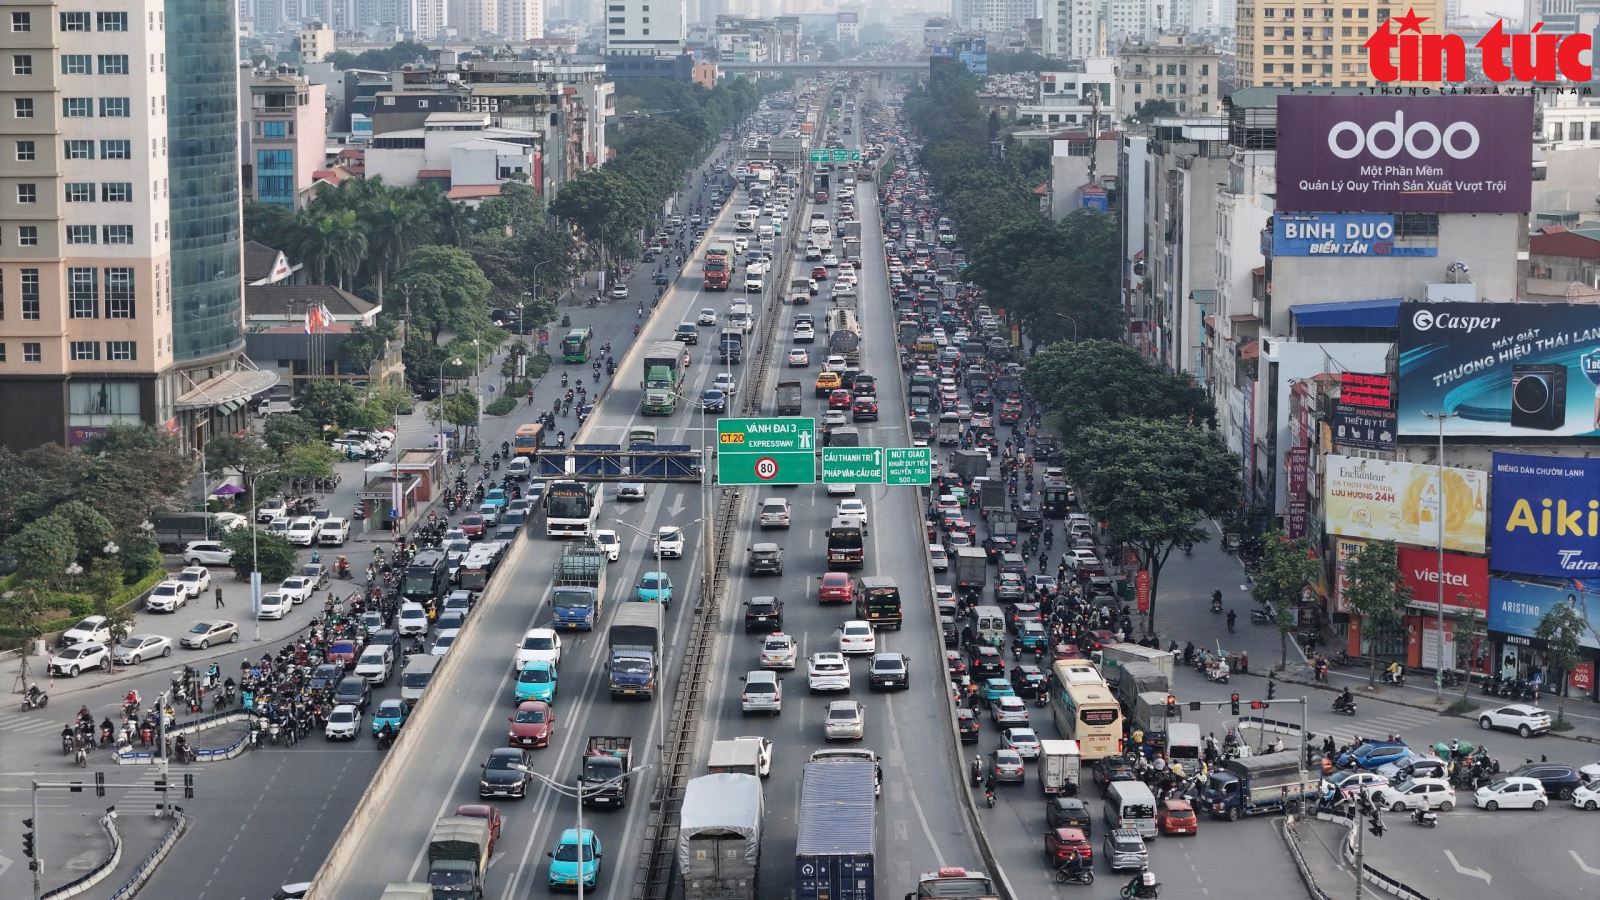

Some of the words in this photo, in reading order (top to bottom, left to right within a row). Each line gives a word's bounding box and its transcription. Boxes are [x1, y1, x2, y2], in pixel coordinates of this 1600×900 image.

[1328, 110, 1480, 160] odoo
[1360, 165, 1383, 178] Một
[1384, 164, 1413, 176] Phần
[1415, 164, 1444, 176] Mềm
[1299, 180, 1329, 192] Quản
[1331, 180, 1344, 194] Lý
[1346, 181, 1369, 194] Quy
[1371, 179, 1401, 191] Trình
[1402, 179, 1424, 191] Sản
[1426, 178, 1453, 191] Xuất
[1454, 180, 1483, 194] Vượt
[1485, 180, 1507, 194] Trội
[1309, 239, 1341, 254] BIẾN
[1435, 313, 1501, 334] Casper
[1491, 334, 1514, 350] MÁY
[1516, 328, 1541, 344] GIẶT
[1432, 355, 1495, 388] THƯƠNG
[1499, 343, 1532, 364] HIỆU
[1535, 331, 1569, 352] THÁI
[745, 422, 772, 433] VÀNH
[772, 424, 790, 433] ĐAI
[790, 424, 797, 433] 3
[720, 434, 744, 443] CT.20
[748, 440, 794, 448] EXPRESSWAY
[907, 450, 925, 458] GIAO
[760, 463, 773, 473] 80
[1340, 466, 1386, 482] Enchanteur
[1497, 463, 1519, 473] MIẾNG
[1564, 469, 1585, 478] LẠNH
[1375, 492, 1395, 502] 24H
[1502, 600, 1540, 617] ARISTINO
[1507, 635, 1530, 646] ARISTINO
